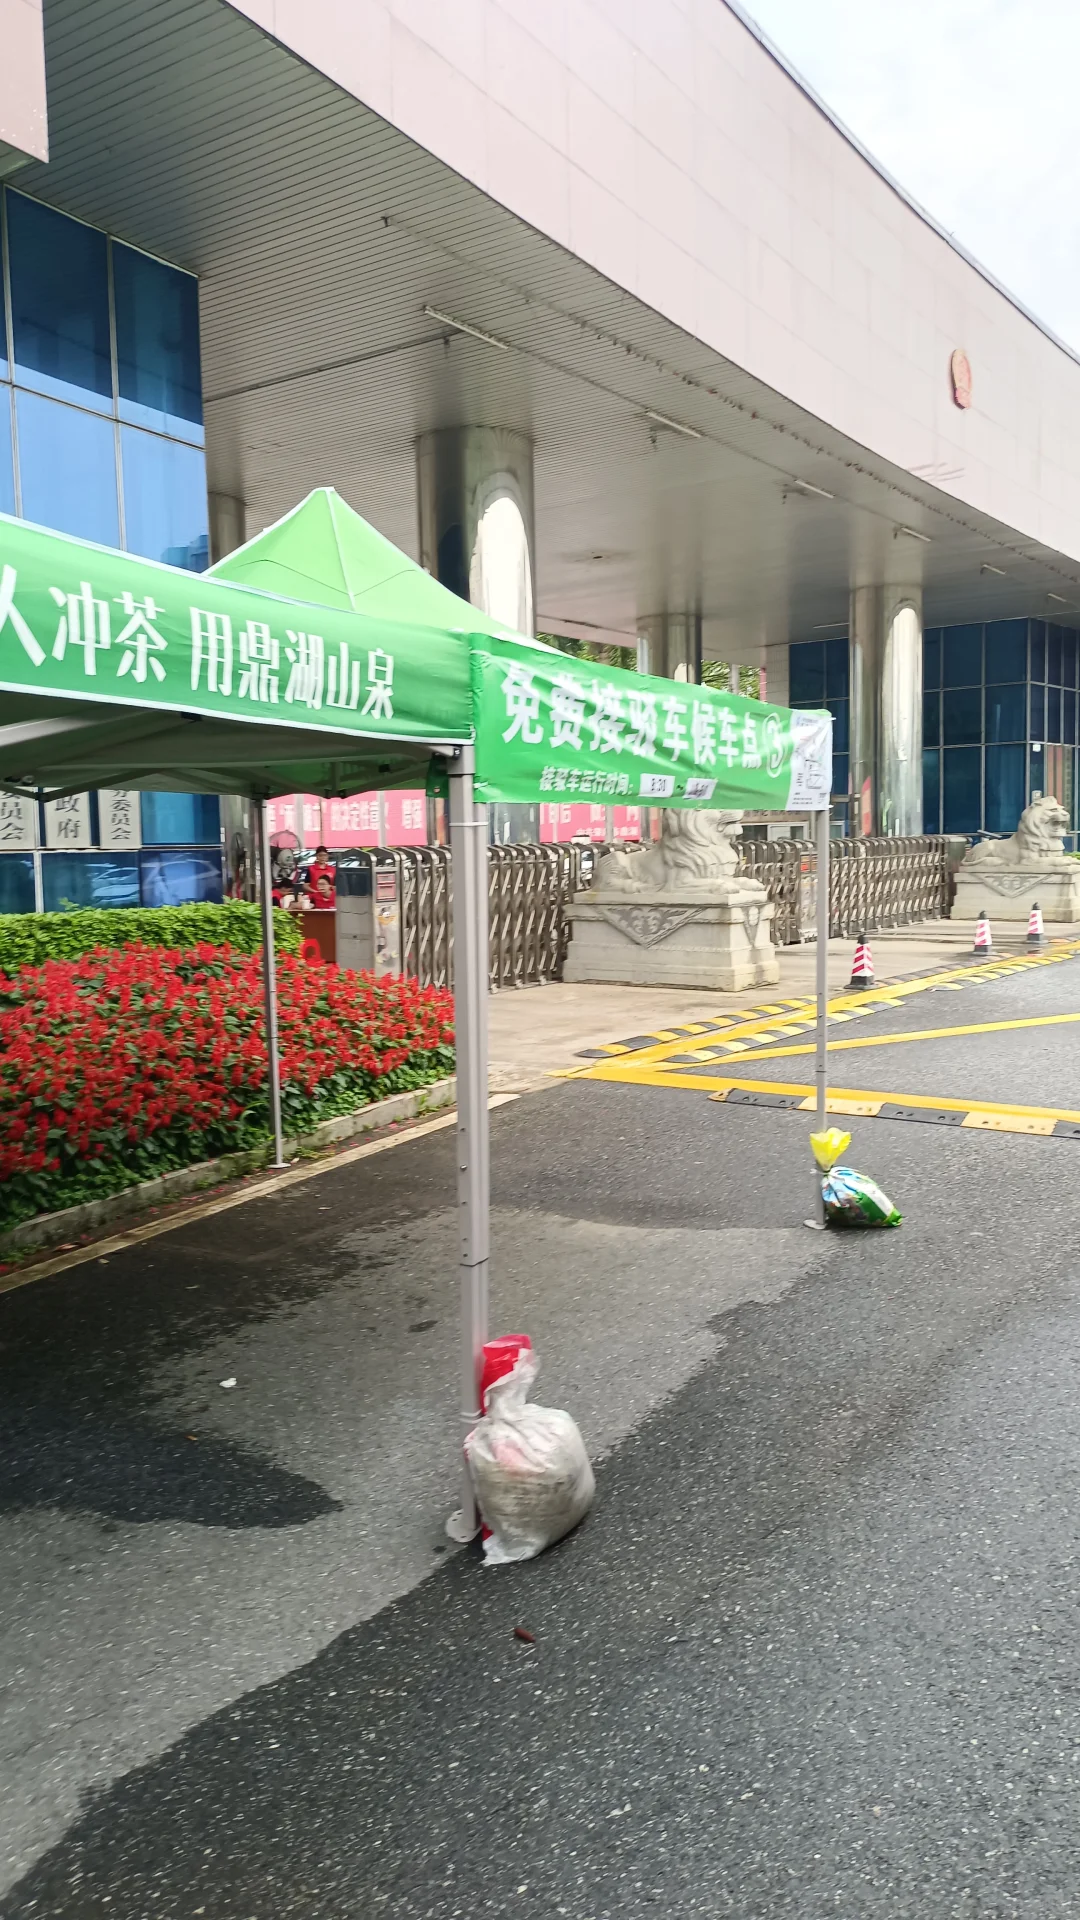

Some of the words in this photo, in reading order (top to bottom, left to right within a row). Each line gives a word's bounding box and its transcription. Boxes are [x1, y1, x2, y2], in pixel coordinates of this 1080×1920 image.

[0, 564, 168, 683] 人冲茶
[189, 607, 394, 720] 用鼎湖山泉
[54, 796, 81, 838] 政府
